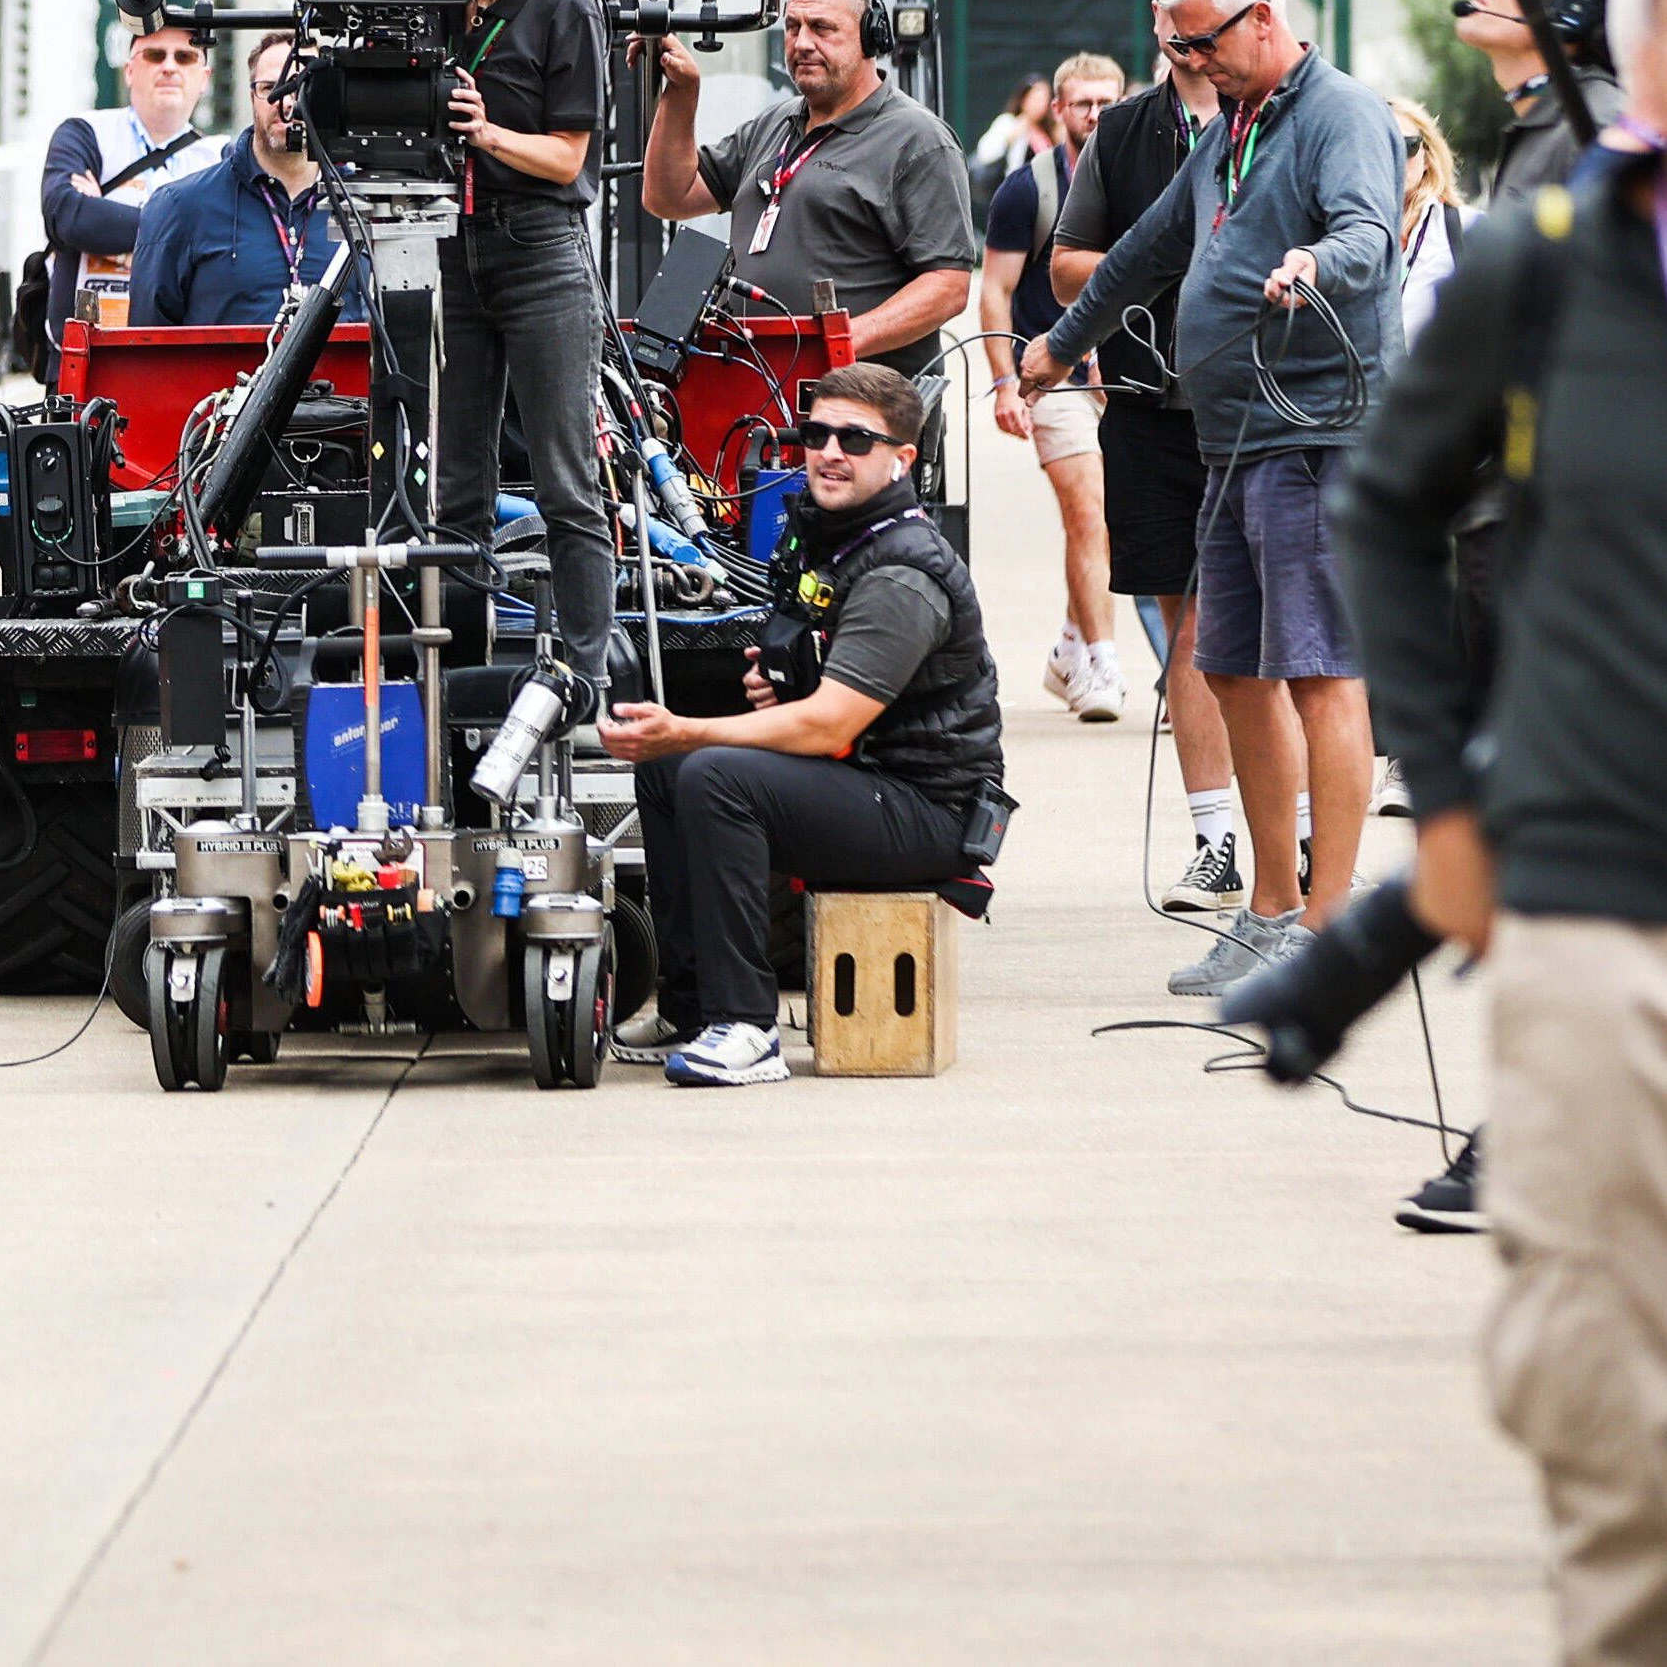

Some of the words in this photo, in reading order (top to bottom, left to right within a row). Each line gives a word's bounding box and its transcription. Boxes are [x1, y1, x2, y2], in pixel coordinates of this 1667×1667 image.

[200, 841, 241, 852] HYBRID
[253, 841, 278, 852] PLUS
[528, 838, 556, 850] PLUS
